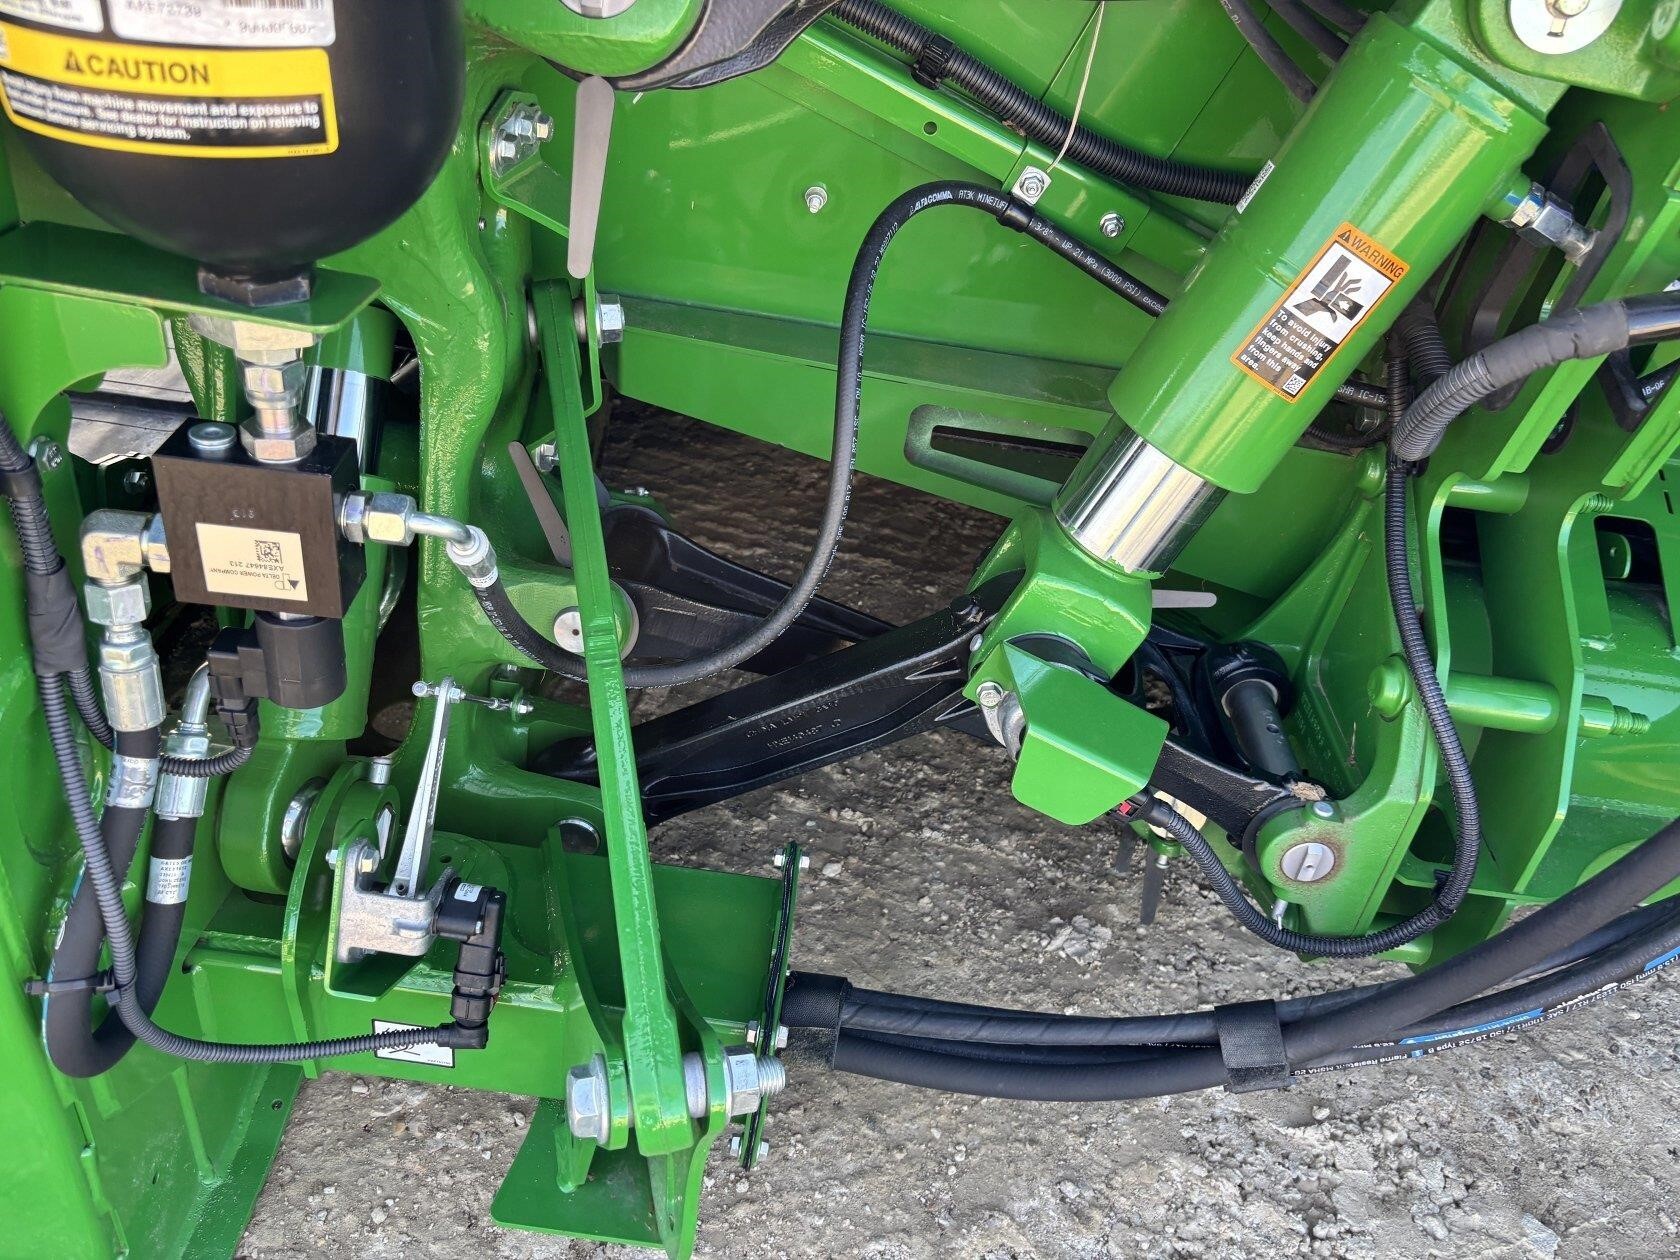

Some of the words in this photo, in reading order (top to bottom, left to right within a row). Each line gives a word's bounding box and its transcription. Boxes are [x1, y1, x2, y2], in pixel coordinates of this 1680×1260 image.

[85, 52, 209, 85] CAUTION
[81, 93, 135, 110] machine
[137, 99, 208, 116] movement
[209, 102, 237, 116] and
[240, 103, 302, 119] exposure
[304, 102, 319, 114] to
[137, 125, 191, 140] system.
[158, 115, 178, 126] for
[180, 115, 249, 129] instruction
[251, 117, 267, 128] on
[269, 115, 320, 129] relieving
[1350, 235, 1404, 279] WARNING
[1084, 253, 1098, 270] MPa
[1100, 266, 1122, 285] (3000
[1123, 280, 1140, 298] PSI)
[1269, 319, 1288, 337] from
[1289, 333, 1324, 362] crushing,
[1277, 310, 1288, 322] To
[1288, 316, 1310, 338] avoid
[1310, 329, 1332, 353] injury
[1247, 344, 1266, 362] from
[1266, 356, 1282, 373] this
[1255, 336, 1281, 359] fingers
[1281, 354, 1302, 373] away
[1262, 328, 1281, 346] keep
[1281, 341, 1304, 361] hands
[1303, 356, 1319, 369] and
[1240, 354, 1259, 371] area.
[240, 570, 262, 578] POWER
[1380, 1053, 1408, 1063] Flame
[1436, 1041, 1457, 1053] Type
[1308, 1066, 1334, 1075] MSHA
